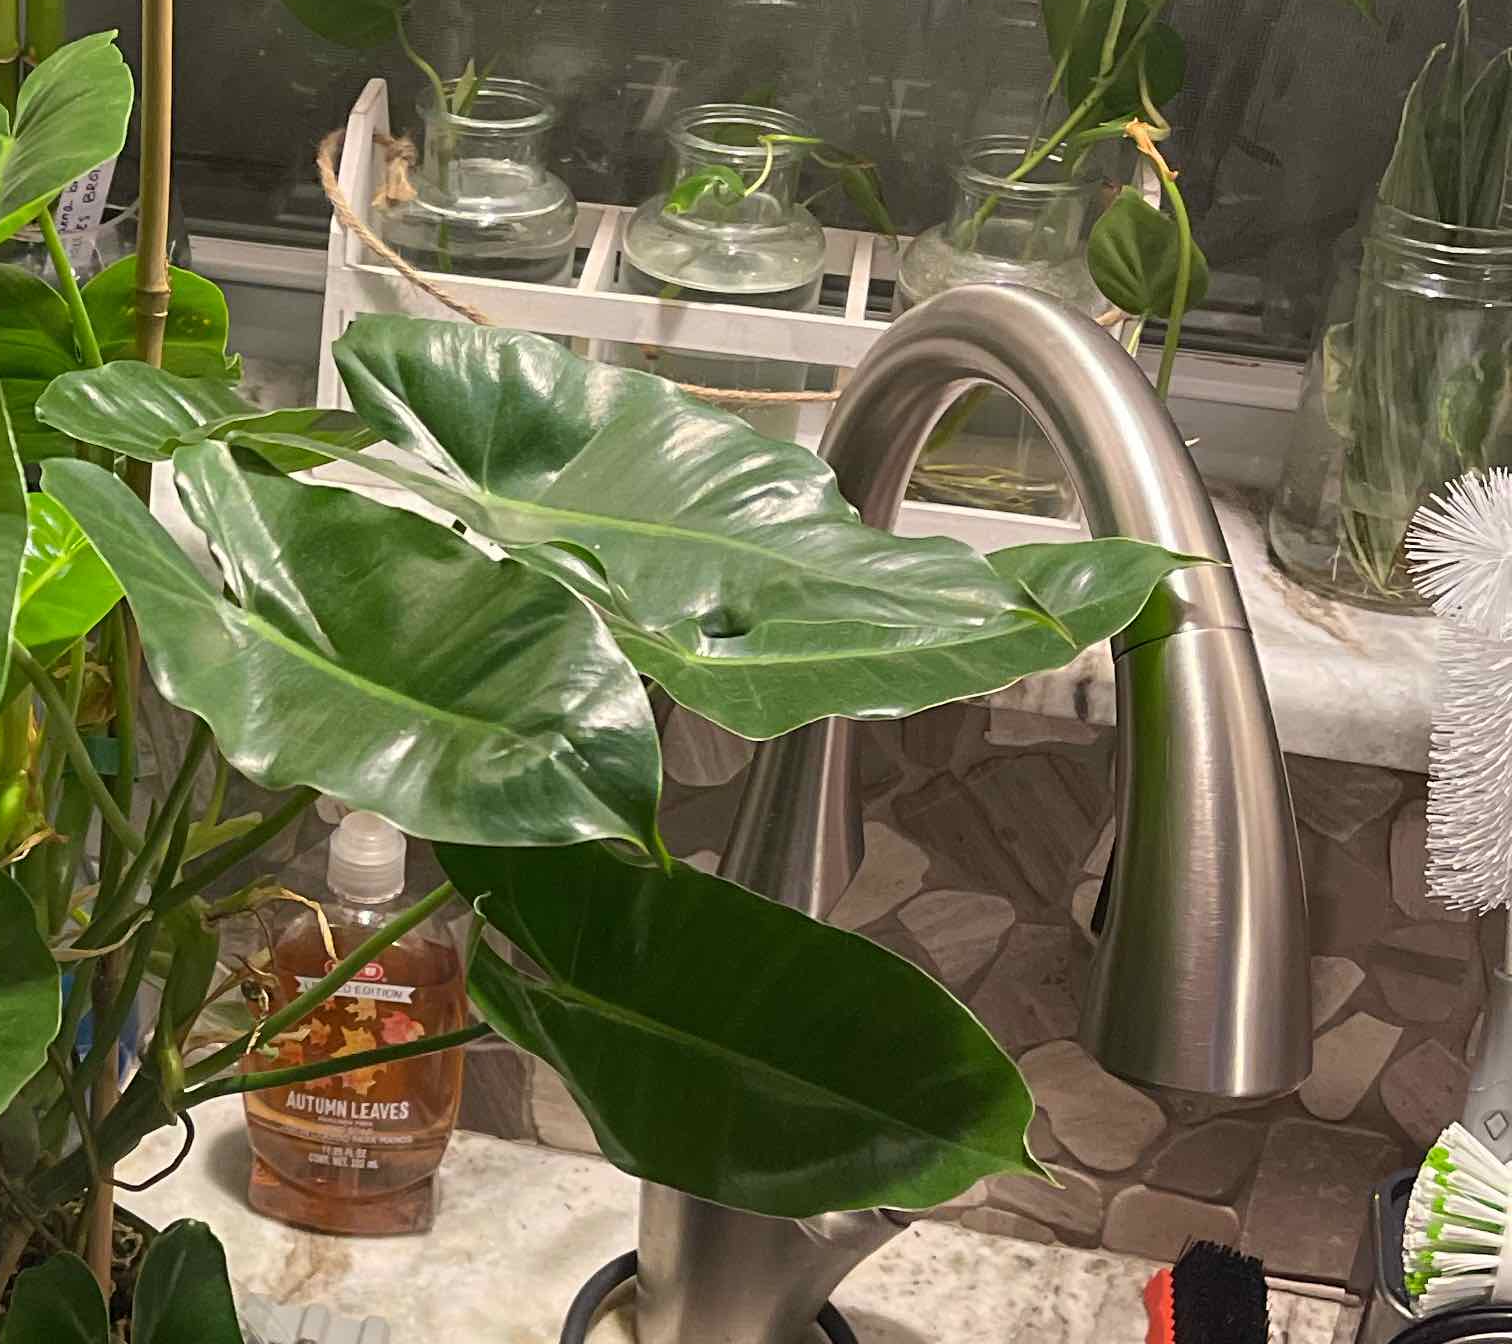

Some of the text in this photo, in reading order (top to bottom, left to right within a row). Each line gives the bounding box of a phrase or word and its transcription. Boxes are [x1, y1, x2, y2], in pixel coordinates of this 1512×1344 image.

[354, 985, 403, 999] EDITION
[286, 1090, 410, 1120] AUTUMN LEAVES
